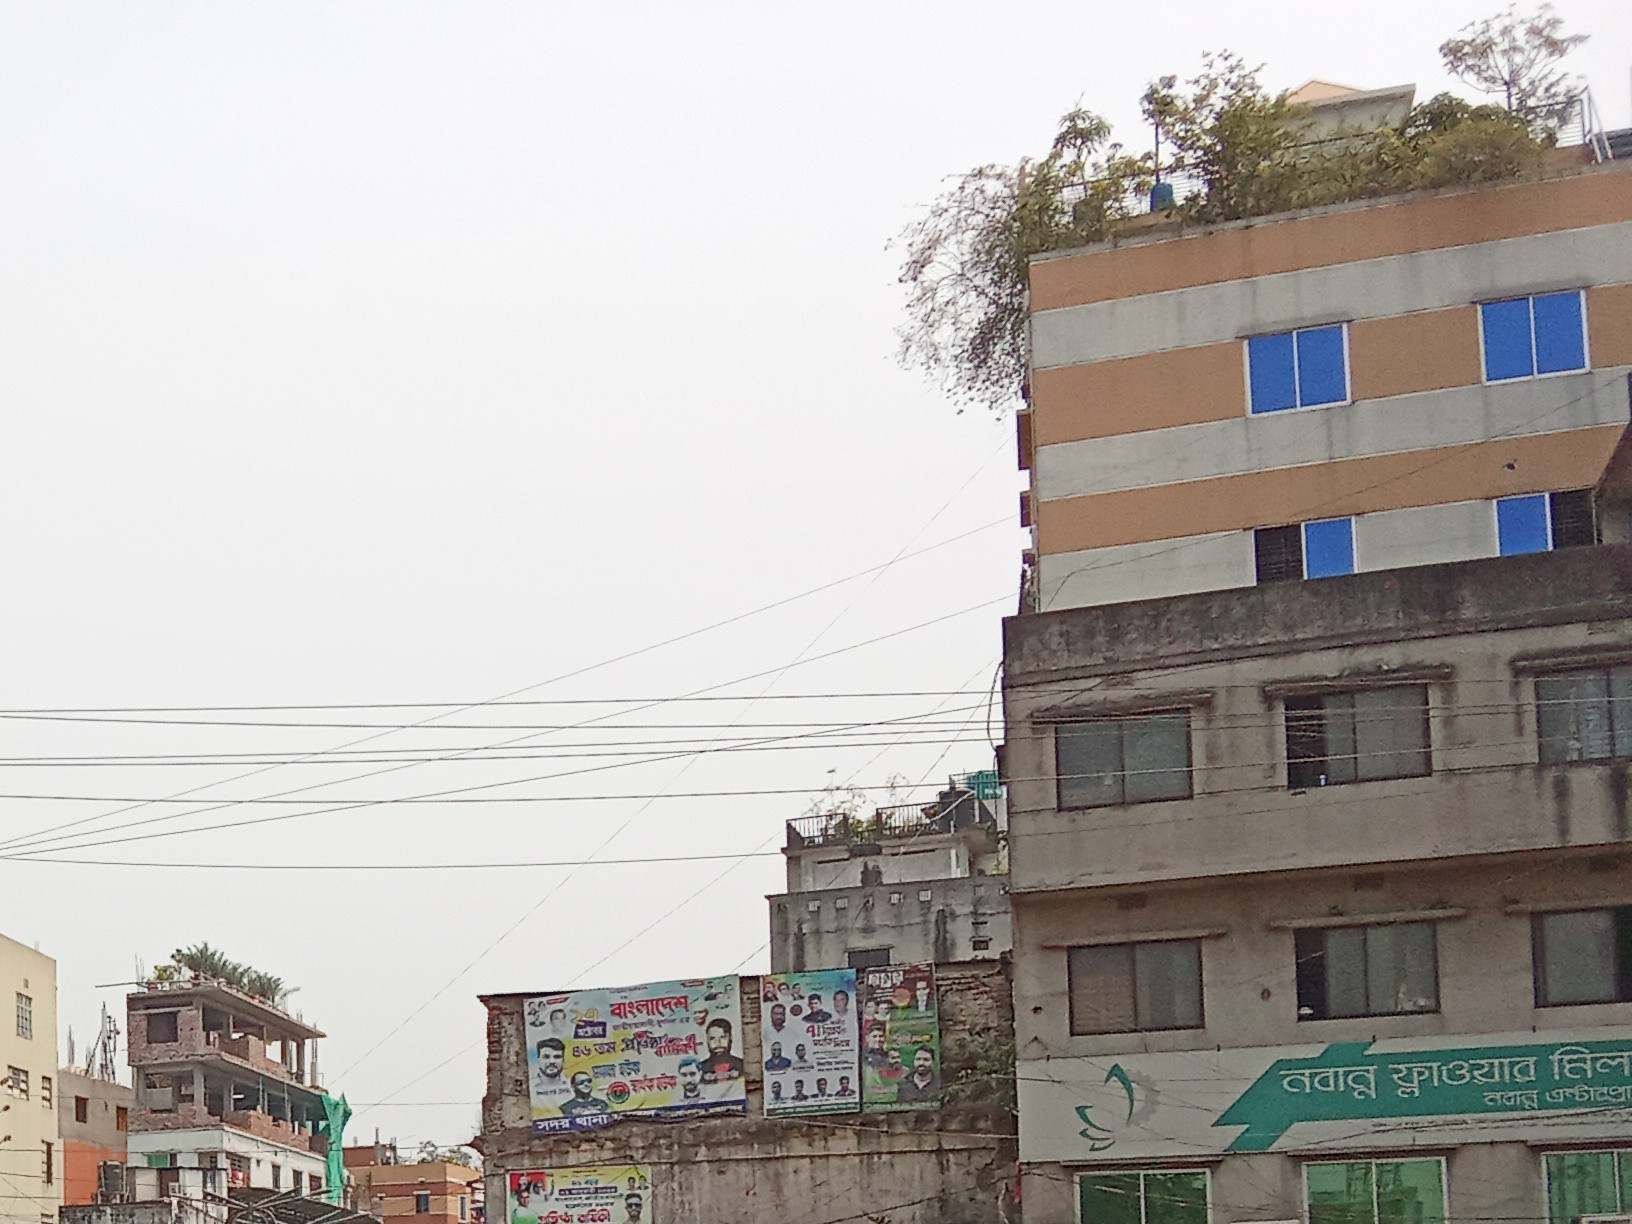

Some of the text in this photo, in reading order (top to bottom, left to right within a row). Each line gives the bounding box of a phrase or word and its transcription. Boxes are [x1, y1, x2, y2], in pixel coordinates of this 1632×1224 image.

[610, 995, 689, 1019] বাংলাদেশ
[1279, 1064, 1378, 1100] নবান্ন
[1388, 1056, 1537, 1099] ফ্লাওয়ার
[1483, 1089, 1539, 1110] নবান্ন
[536, 1114, 608, 1132] সদর থানা
